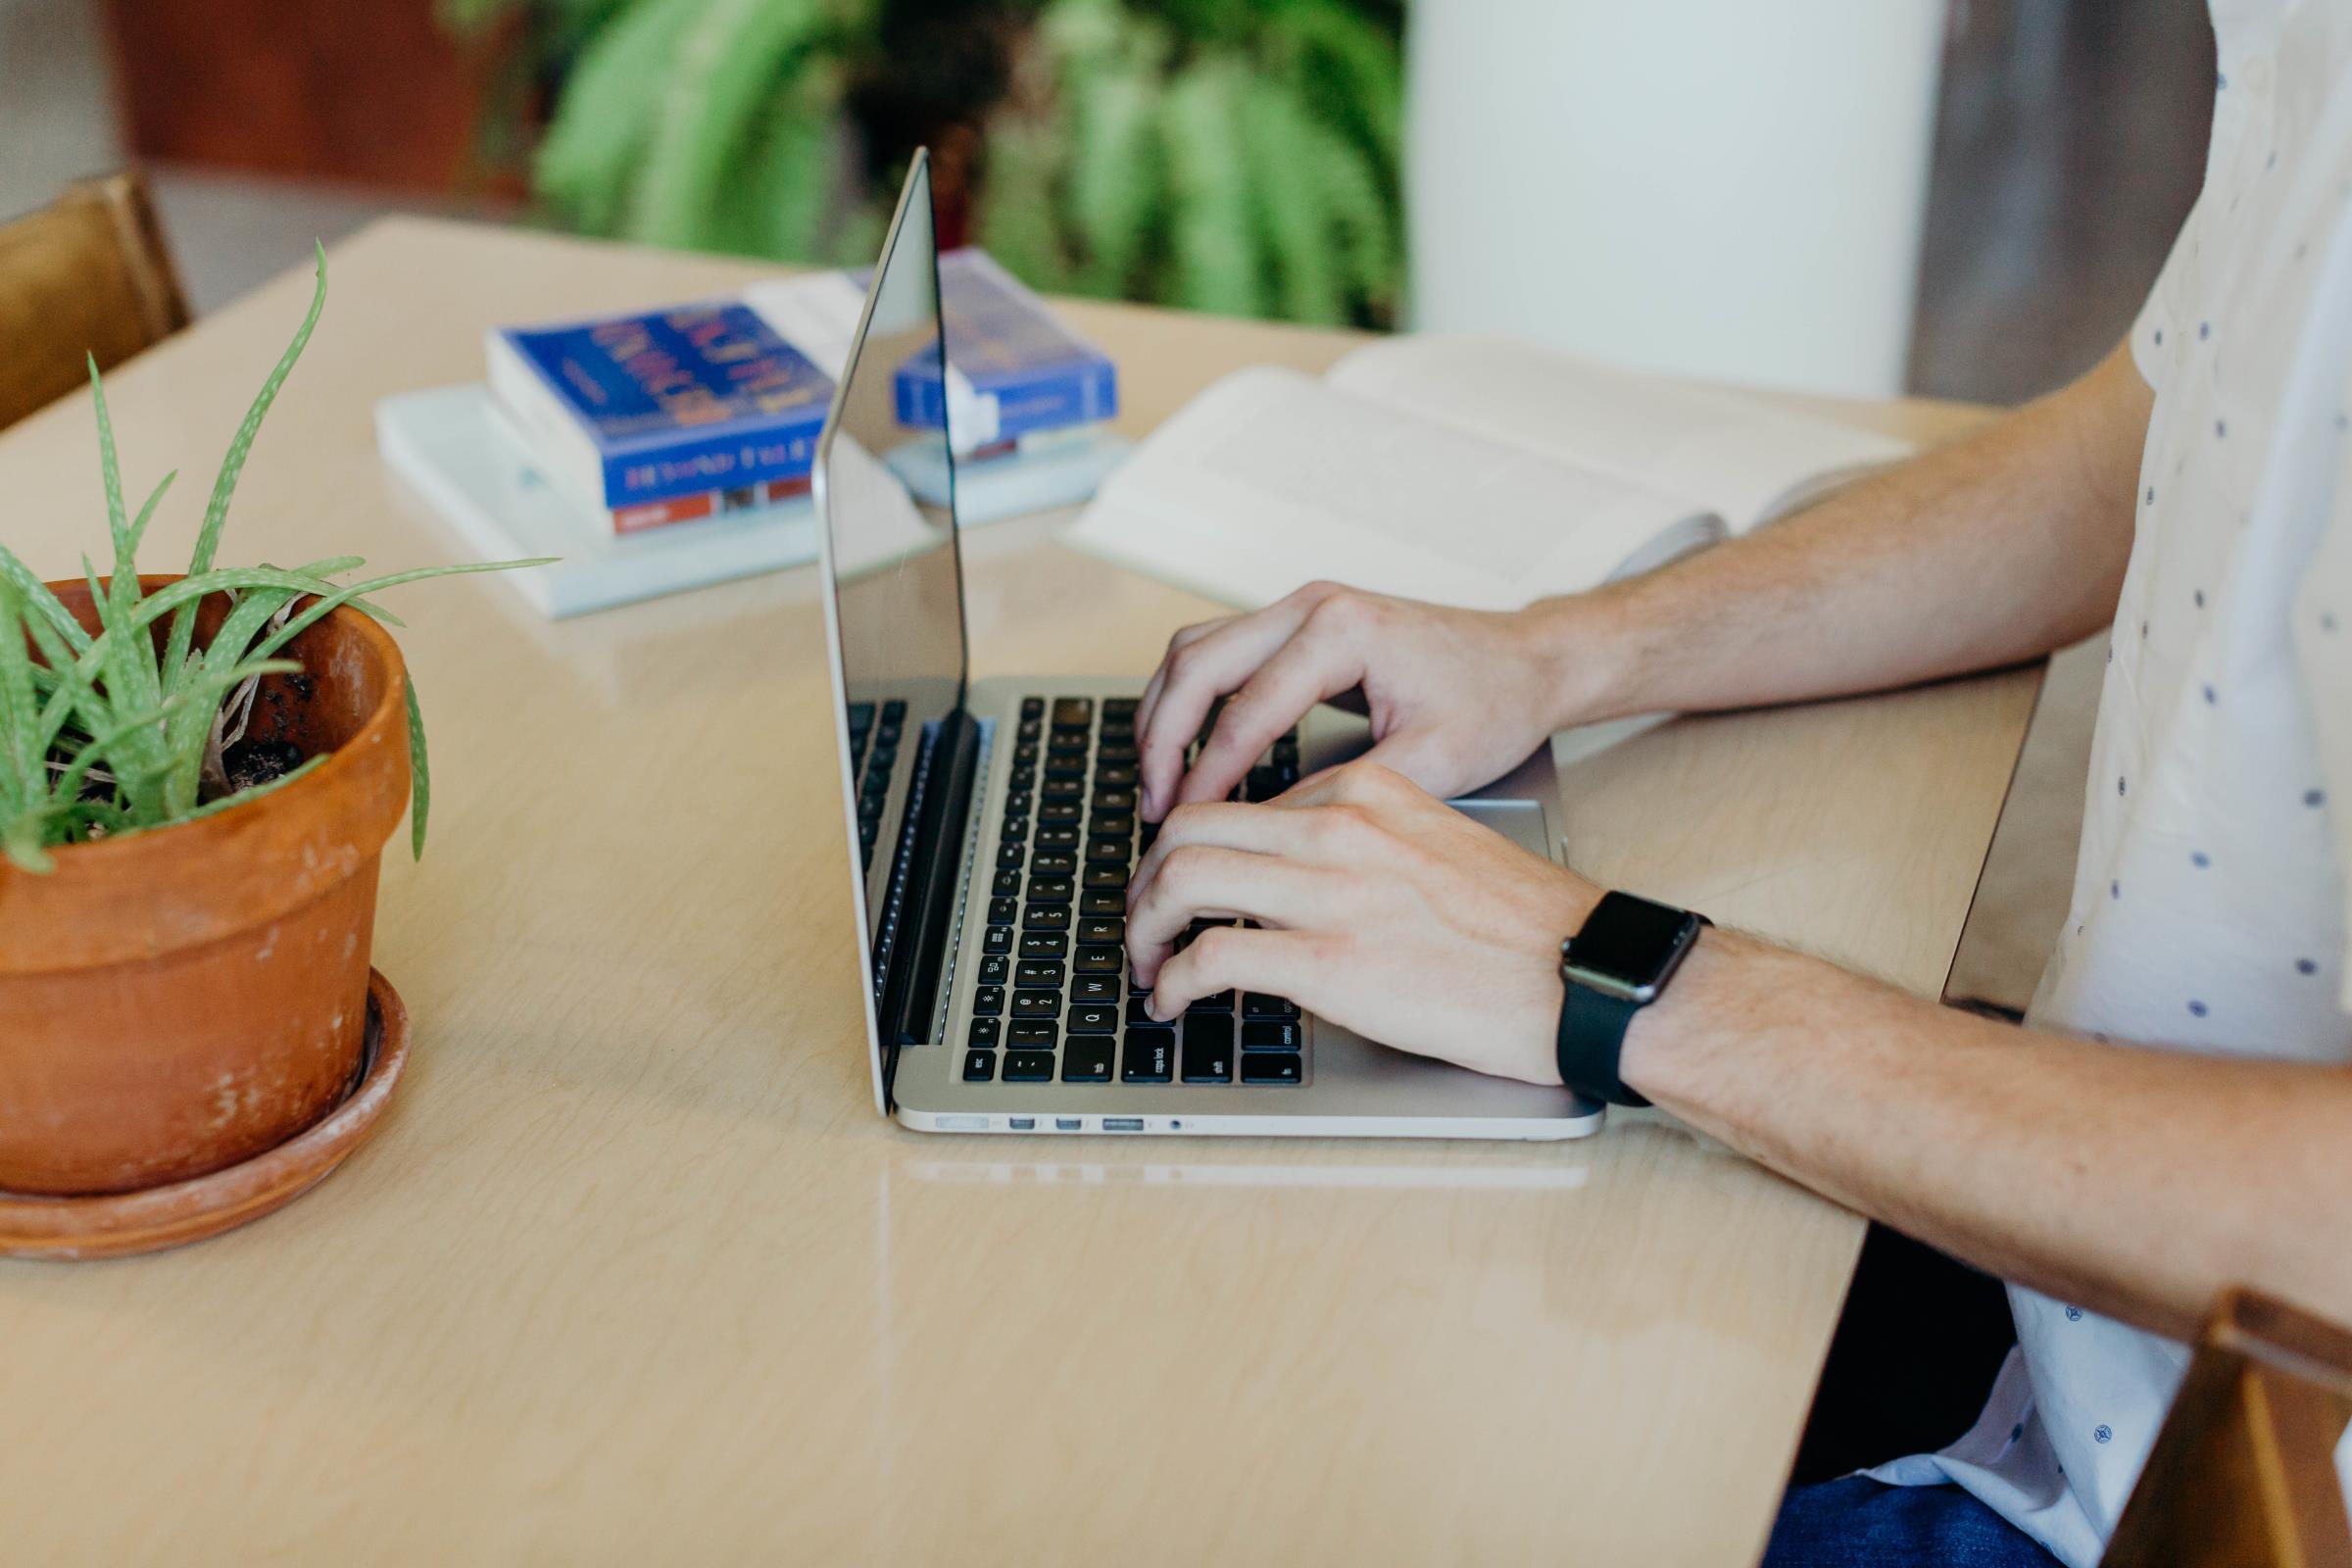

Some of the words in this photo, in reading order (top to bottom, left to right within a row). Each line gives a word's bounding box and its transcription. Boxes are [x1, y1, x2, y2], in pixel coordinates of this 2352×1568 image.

[1283, 1026, 1292, 1044] control
[1154, 1048, 1164, 1058] lock
[974, 1057, 984, 1069] esc
[1154, 1059, 1165, 1074] caps
[1213, 1061, 1222, 1073] shift
